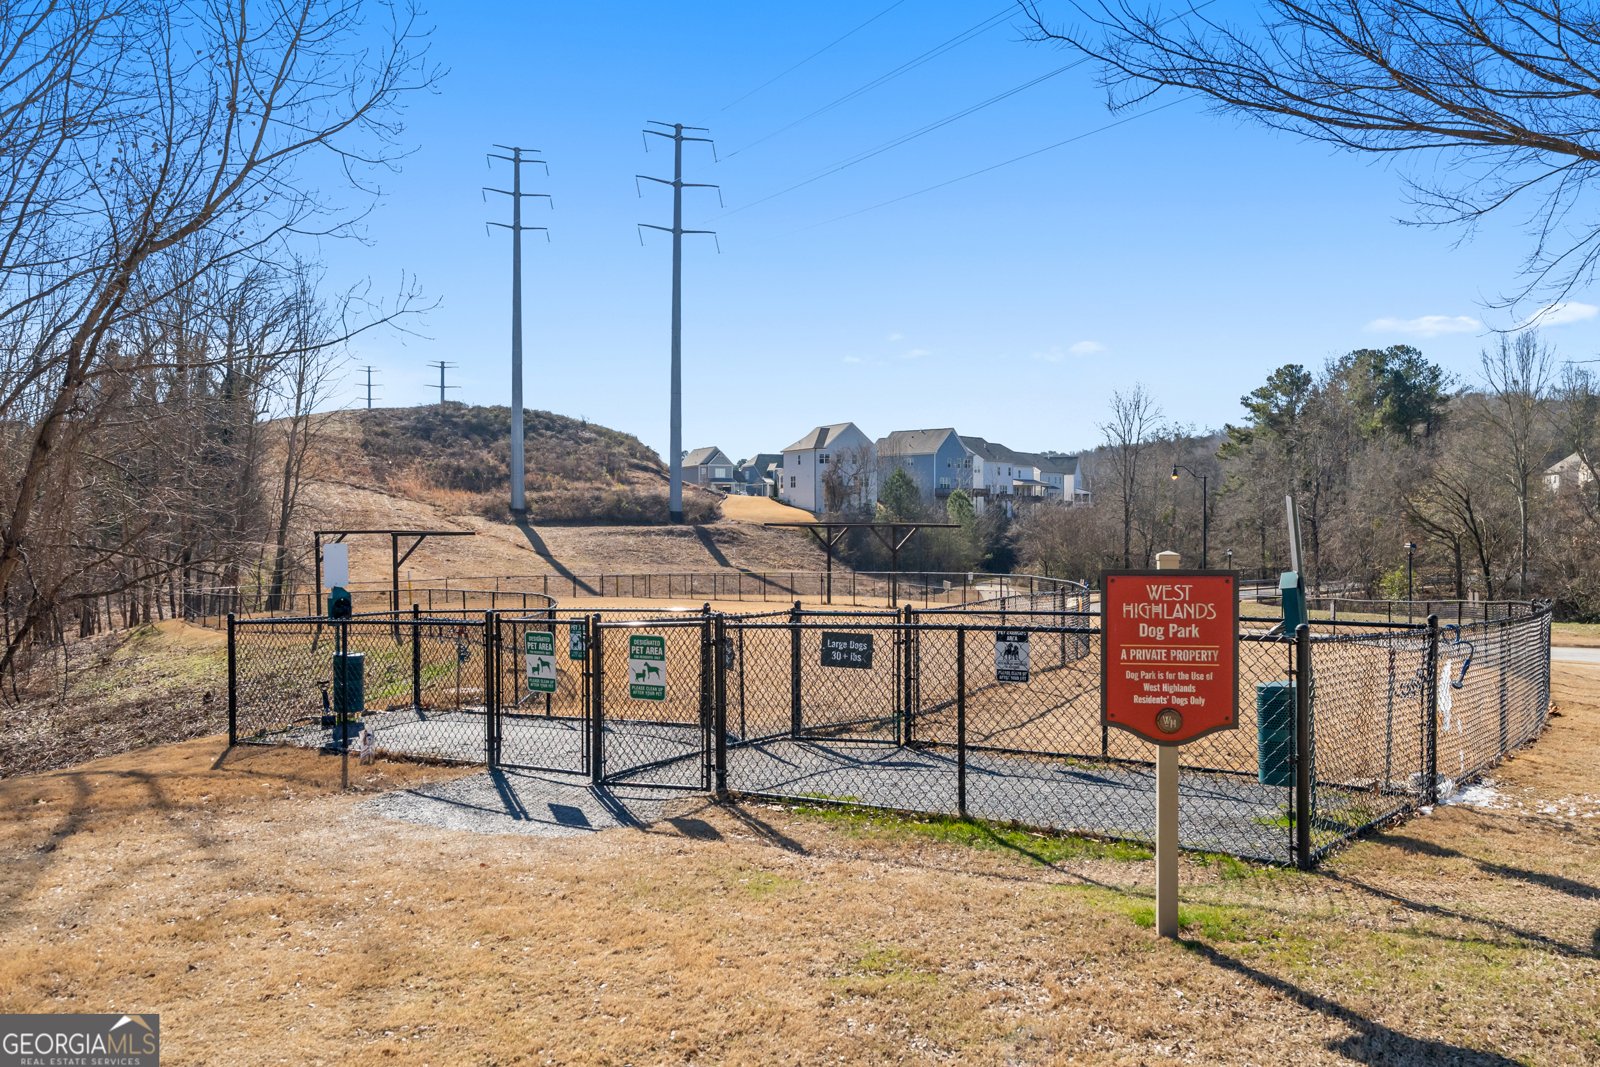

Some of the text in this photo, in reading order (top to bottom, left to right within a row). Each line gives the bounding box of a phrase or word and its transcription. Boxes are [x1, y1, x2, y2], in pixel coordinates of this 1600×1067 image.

[1146, 584, 1192, 600] WEST
[1122, 602, 1216, 620] HIGHLANDS
[1139, 623, 1200, 640] Dog Park
[539, 642, 552, 651] AREA
[632, 646, 662, 655] PET AREA
[828, 640, 868, 651] Large Dogs
[832, 651, 841, 660] 30
[850, 652, 862, 661] lbs
[1120, 648, 1218, 662] A PRIVATE PROPERTY
[1126, 670, 1213, 680] Dog Park is for the Use of
[1143, 683, 1196, 694] West Highlands
[1134, 695, 1205, 706] Residents' Dogs Only
